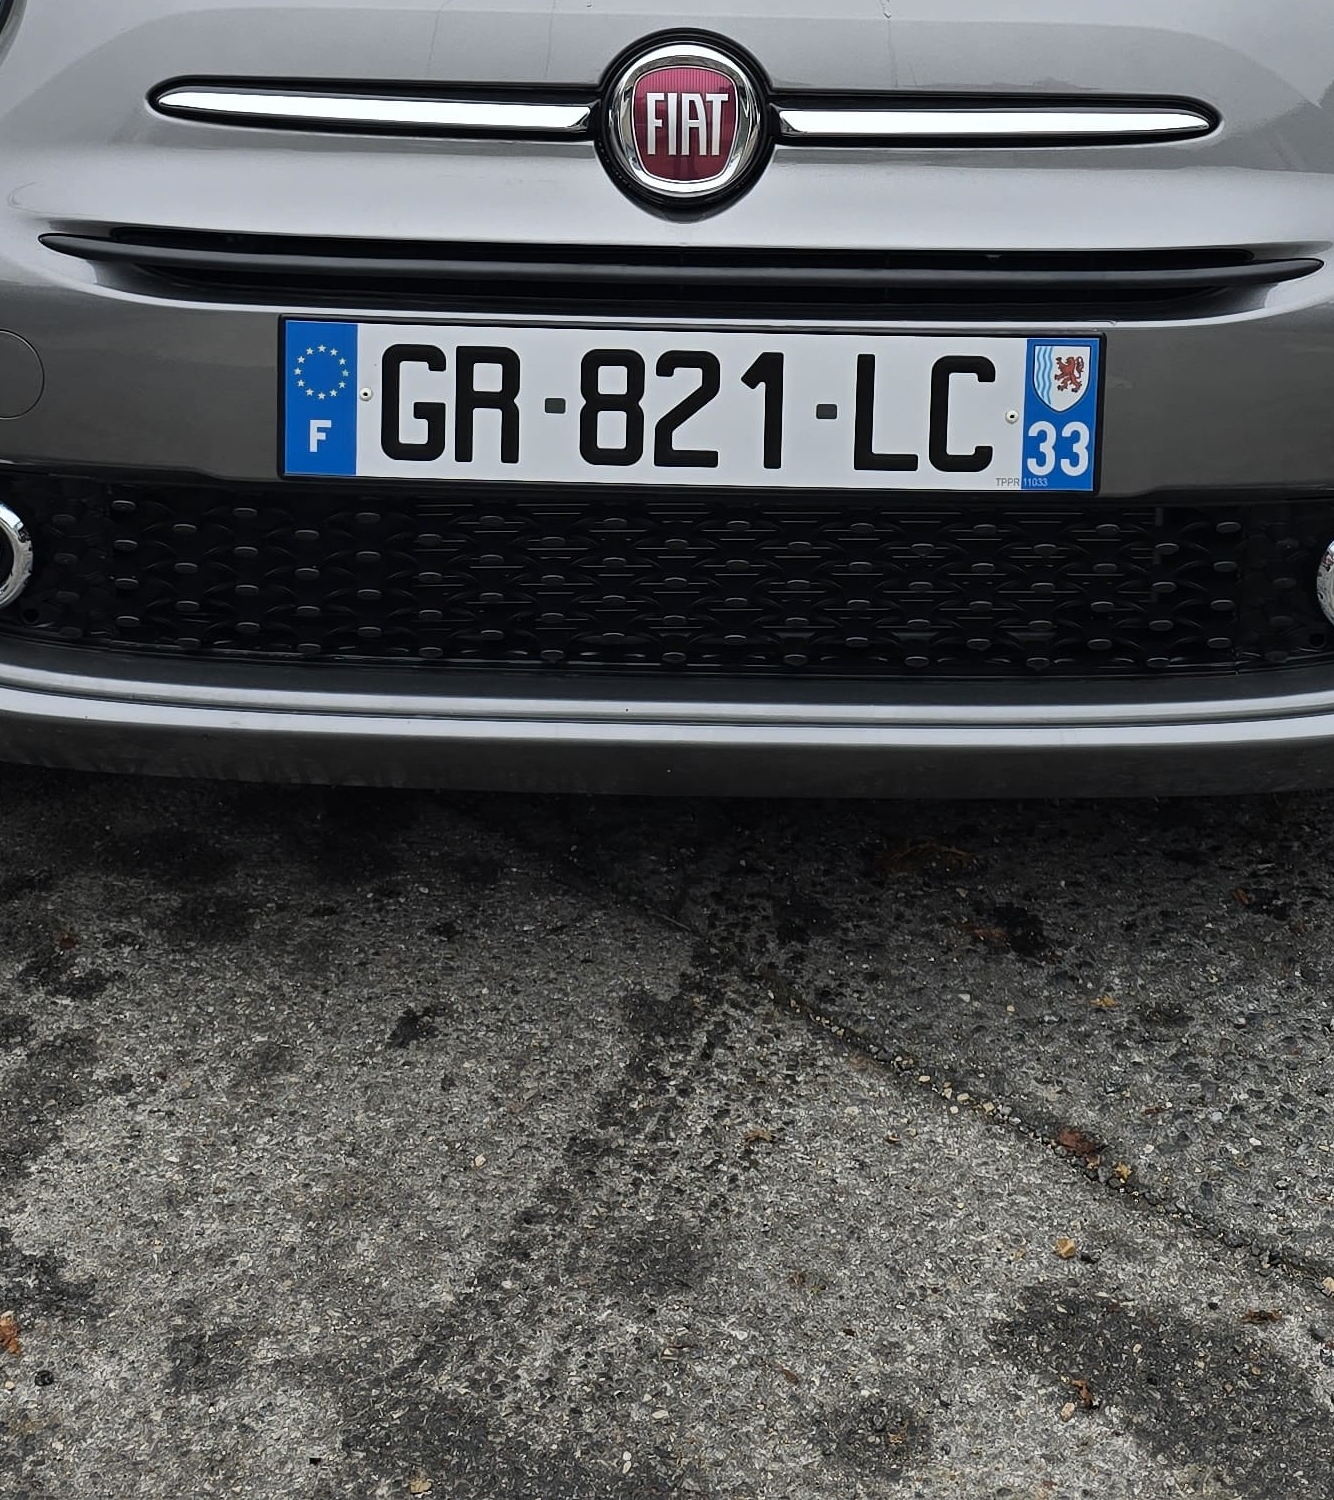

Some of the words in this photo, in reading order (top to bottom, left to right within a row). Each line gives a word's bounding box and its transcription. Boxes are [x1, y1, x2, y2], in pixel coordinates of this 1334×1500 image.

[645, 90, 730, 158] FIAT
[308, 418, 333, 454] F
[378, 342, 997, 474] GR-821-LC
[1026, 420, 1091, 478] 33
